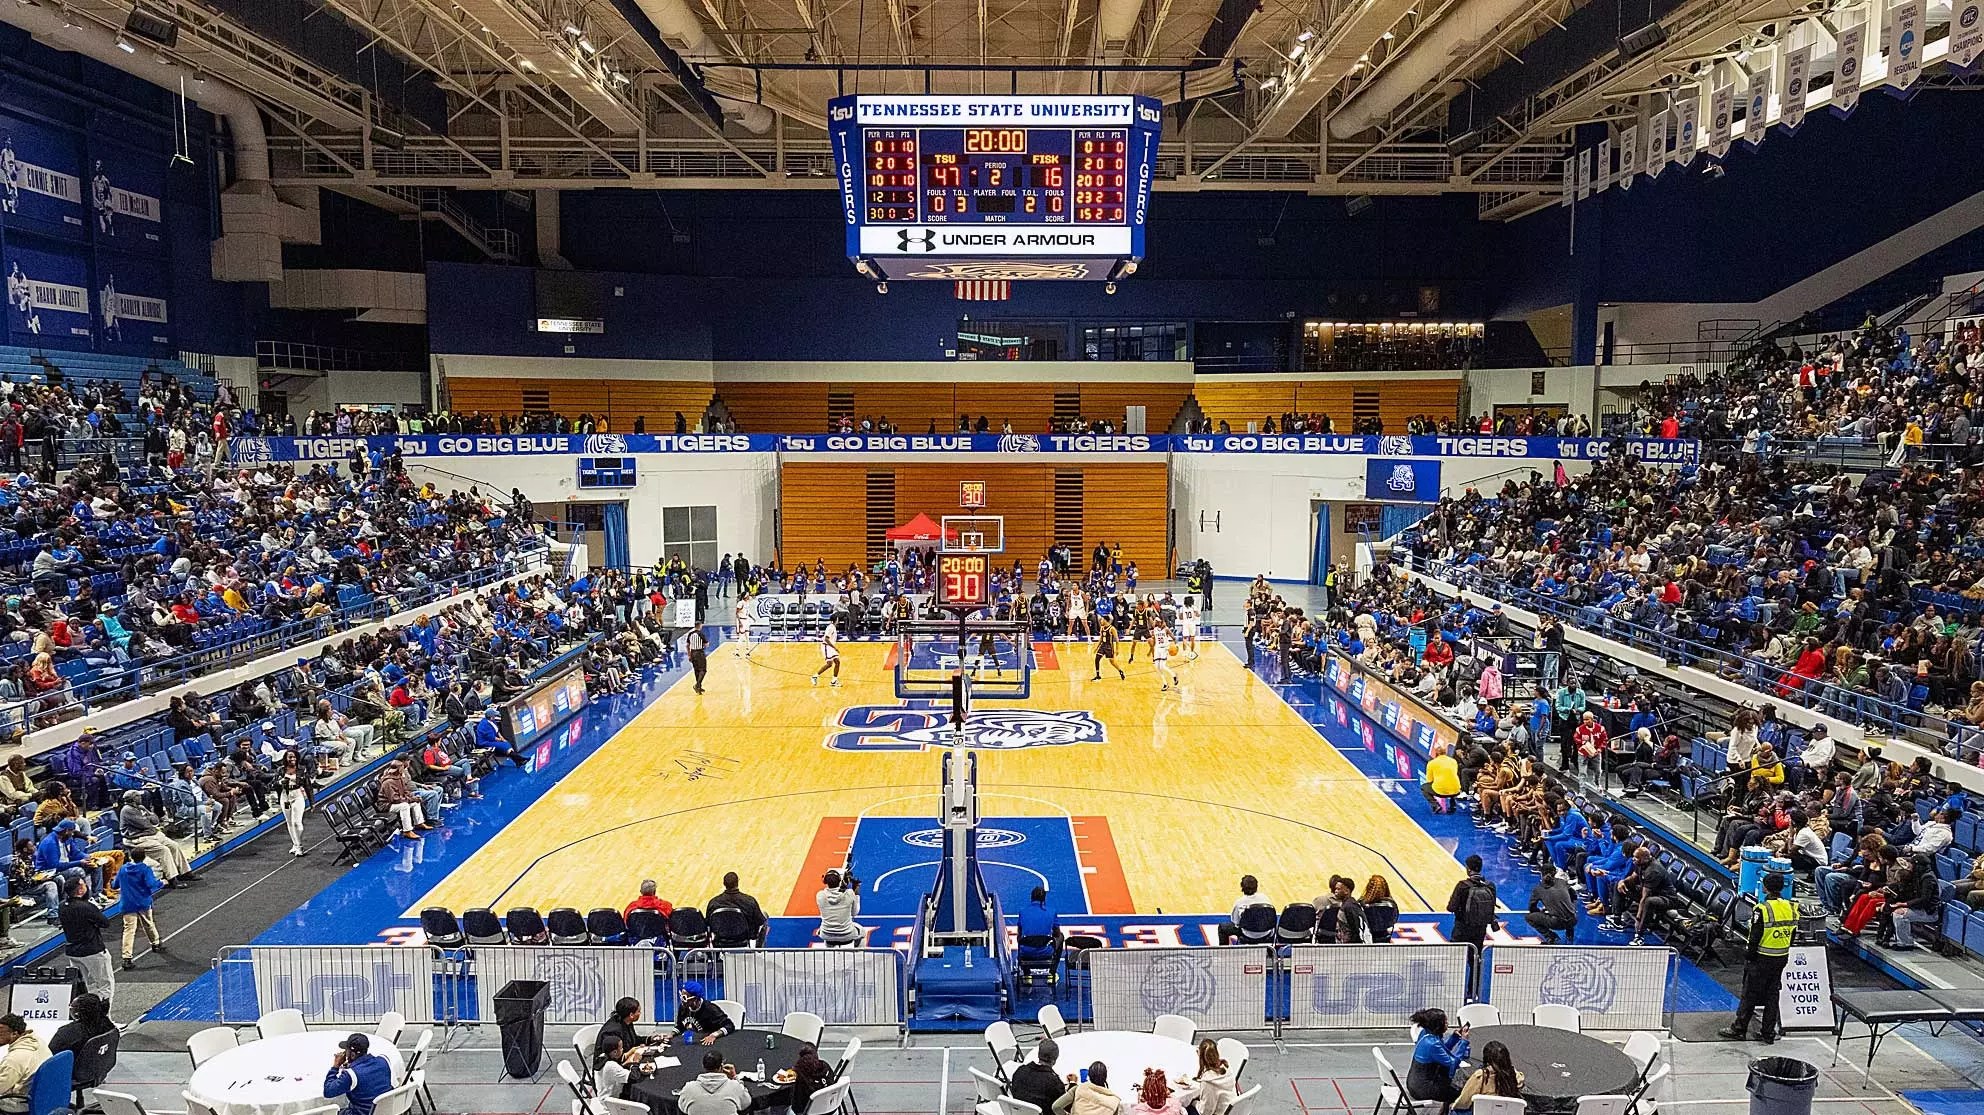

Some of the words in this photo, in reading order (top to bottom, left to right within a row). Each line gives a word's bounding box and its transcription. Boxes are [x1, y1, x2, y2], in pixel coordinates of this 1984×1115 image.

[1953, 34, 1983, 53] CHAMPIONS
[1894, 61, 1918, 76] REGIONAL
[1836, 83, 1860, 98] CHAMPIONS
[860, 104, 961, 116] TENNESSEE
[968, 104, 1023, 116] STATE
[1030, 104, 1130, 116] UNIVERSITY
[875, 141, 883, 152] 0
[902, 141, 914, 152] 10
[967, 131, 1024, 151] 20:00
[1084, 141, 1092, 153] 0
[1116, 142, 1123, 153] 0
[875, 158, 883, 169] 2
[887, 158, 895, 169] 0
[907, 158, 914, 169] 5
[934, 154, 956, 164] TSU
[1032, 154, 1059, 164] FISK
[1084, 159, 1092, 170] 2
[1096, 158, 1103, 169] 0
[1115, 159, 1122, 170] 0
[839, 132, 856, 225] TIGERS
[872, 175, 884, 186] 10
[903, 175, 915, 186] 10
[934, 167, 959, 186] 47
[991, 169, 1001, 185] 2
[1045, 168, 1062, 187] 16
[1077, 175, 1092, 187] 20
[1096, 175, 1103, 187] 0
[1115, 175, 1123, 187] 0
[1135, 132, 1152, 225] TIGERS
[872, 192, 884, 202] 12
[907, 192, 914, 202] 5
[1095, 192, 1103, 203] 2
[934, 197, 944, 212] 0
[957, 197, 966, 212] 3
[1025, 197, 1035, 212] 2
[1052, 197, 1062, 212] 0
[870, 208, 884, 219] 30
[888, 208, 896, 219] 0
[1079, 208, 1092, 219] 15
[1095, 208, 1103, 219] 2
[942, 235, 1006, 245] UNDER
[1013, 235, 1095, 245] ARMOUR
[36, 285, 57, 304] SHARON
[438, 438, 472, 452] GO
[476, 438, 513, 452] BIG
[516, 438, 569, 452] BLUE
[654, 437, 750, 451] TIGERS
[827, 437, 862, 450] GO
[867, 437, 908, 450] BIG
[911, 437, 972, 450] BLUE
[1050, 437, 1151, 451] TIGERS
[1224, 437, 1258, 451] GO
[1262, 437, 1300, 451] BIG
[1304, 437, 1364, 451] BLUE
[1436, 439, 1528, 457] TIGERS
[1646, 442, 1695, 460] BLUE
[964, 491, 981, 504] 30
[942, 557, 984, 572] 20:00
[947, 573, 979, 599] 30
[1786, 971, 1818, 980] PLEASE
[1787, 983, 1820, 991] WATCH
[1791, 994, 1819, 1003] YOUR
[23, 1009, 58, 1019] PLEASE
[1796, 1006, 1817, 1015] STEP
